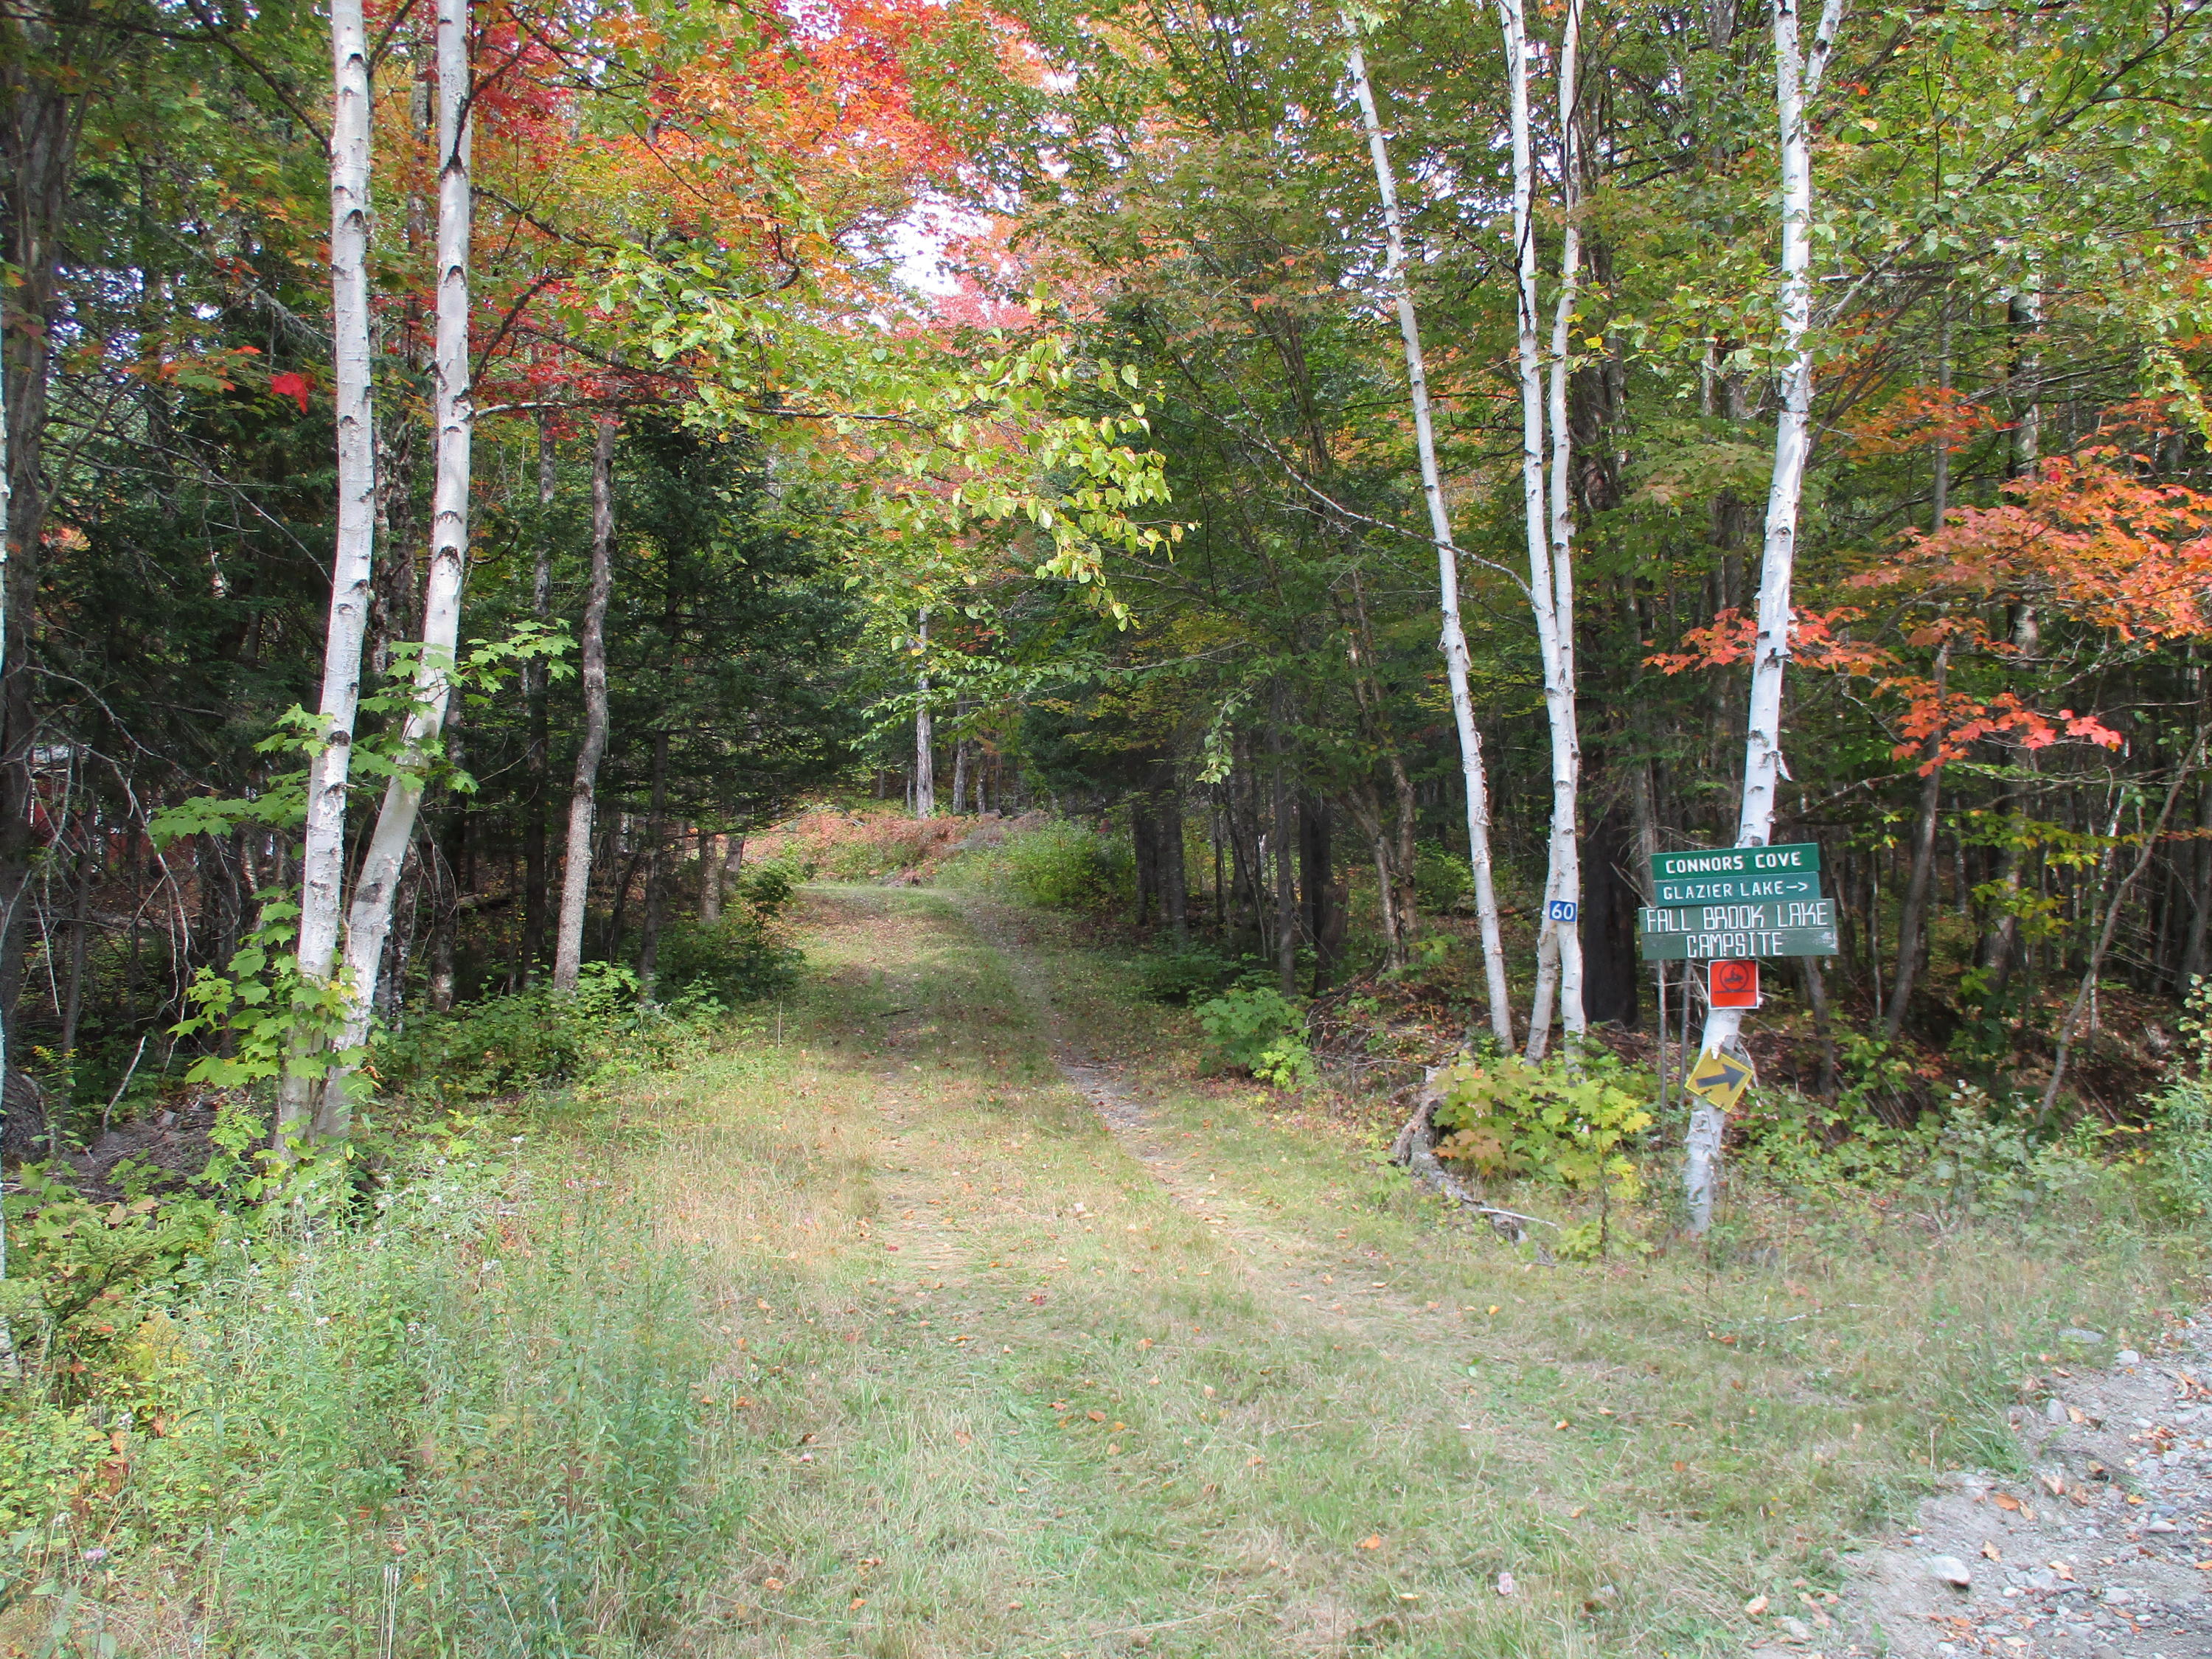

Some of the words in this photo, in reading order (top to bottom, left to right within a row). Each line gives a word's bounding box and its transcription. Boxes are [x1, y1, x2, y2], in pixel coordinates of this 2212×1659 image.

[1665, 855, 1744, 874] CONNORS
[1755, 851, 1802, 869] COVE
[1663, 883, 1733, 900] GLAZIER
[1740, 880, 1784, 897] LAKE
[1551, 902, 1574, 920] 60
[1646, 908, 1691, 933] FALL
[1703, 905, 1764, 931] BROOK
[1776, 902, 1828, 928] LAKE
[1687, 931, 1784, 958] CAMPSITE
